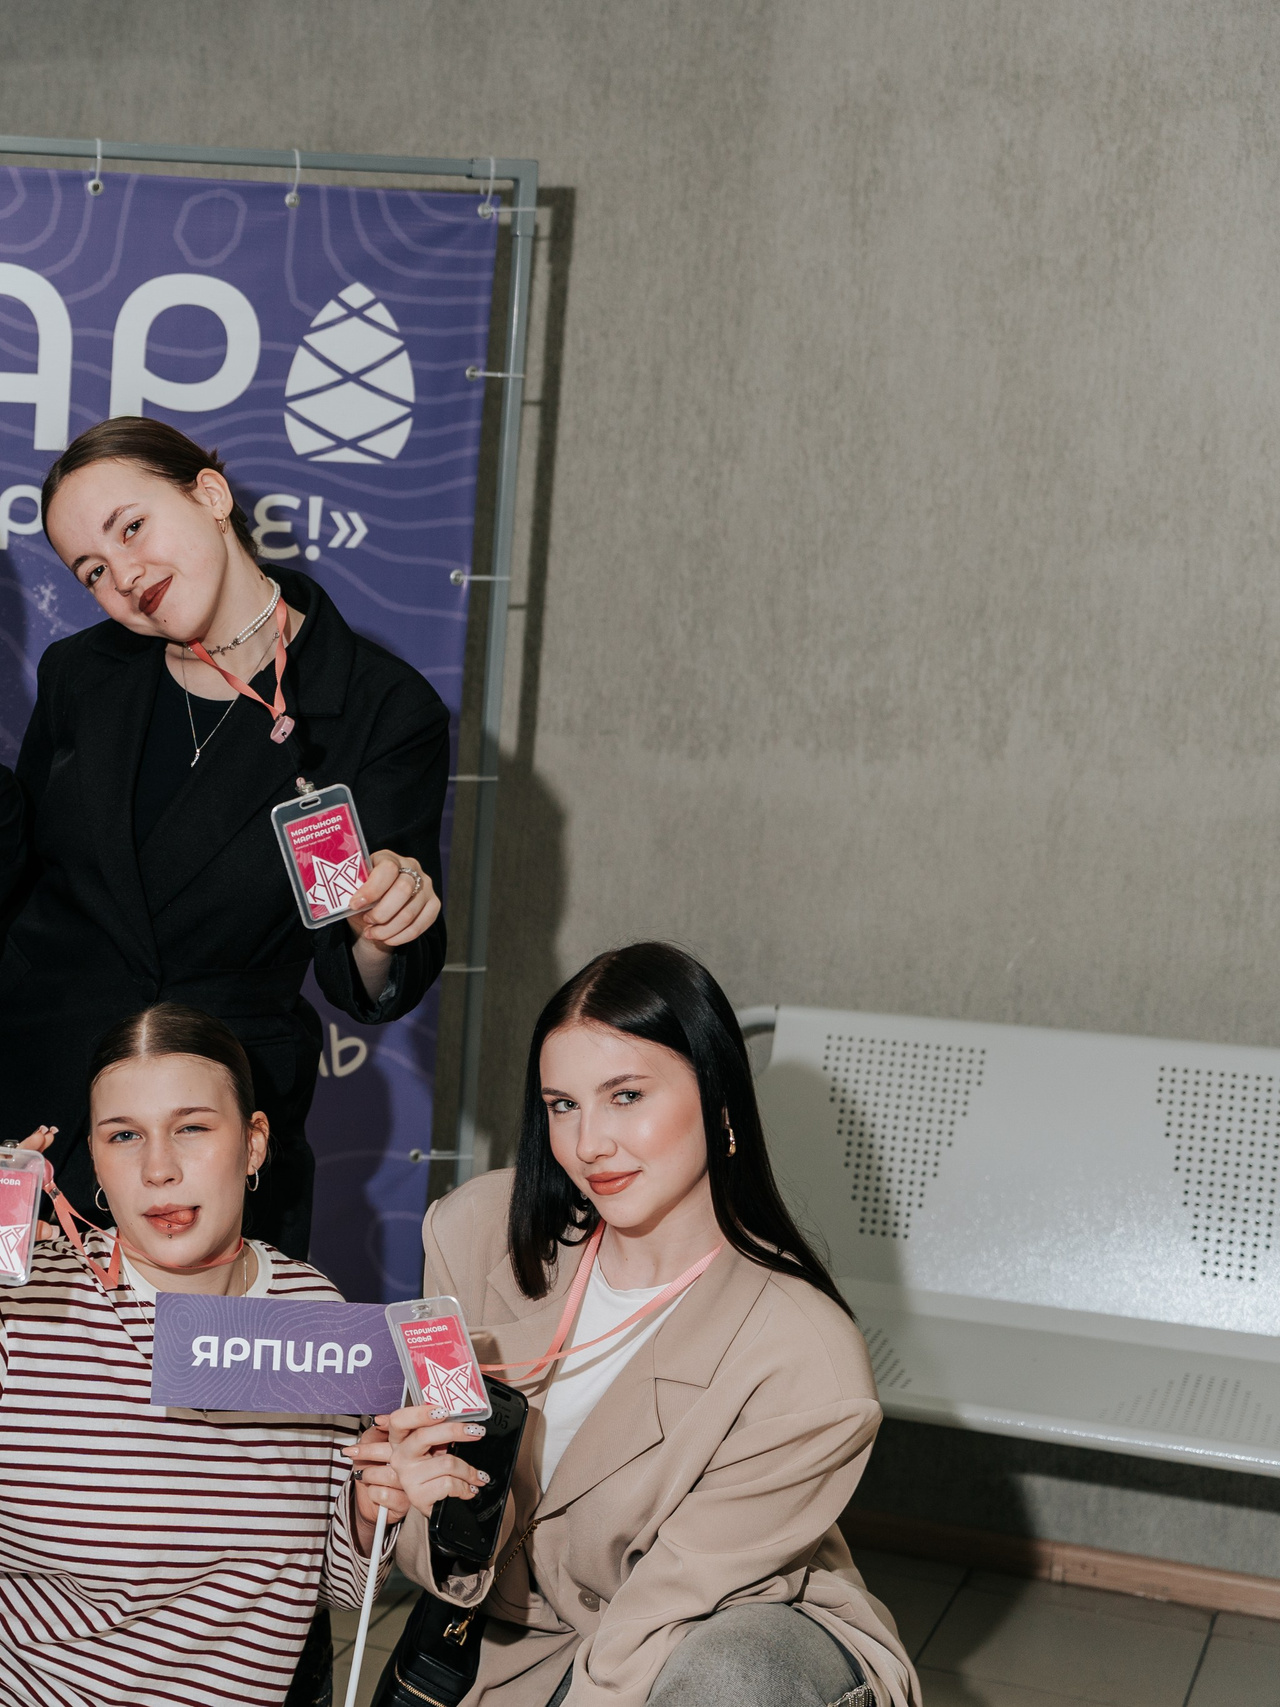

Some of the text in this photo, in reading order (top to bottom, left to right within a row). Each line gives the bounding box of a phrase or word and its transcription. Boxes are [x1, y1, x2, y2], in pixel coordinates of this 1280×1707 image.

[290, 815, 342, 838] МАРТЫНОВА
[293, 824, 341, 846] МАРГАРИТА
[404, 1324, 448, 1337] СТАРИКОВА
[406, 1335, 433, 1344] СОФЬЯ
[191, 1335, 372, 1374] ЯРПИАР
